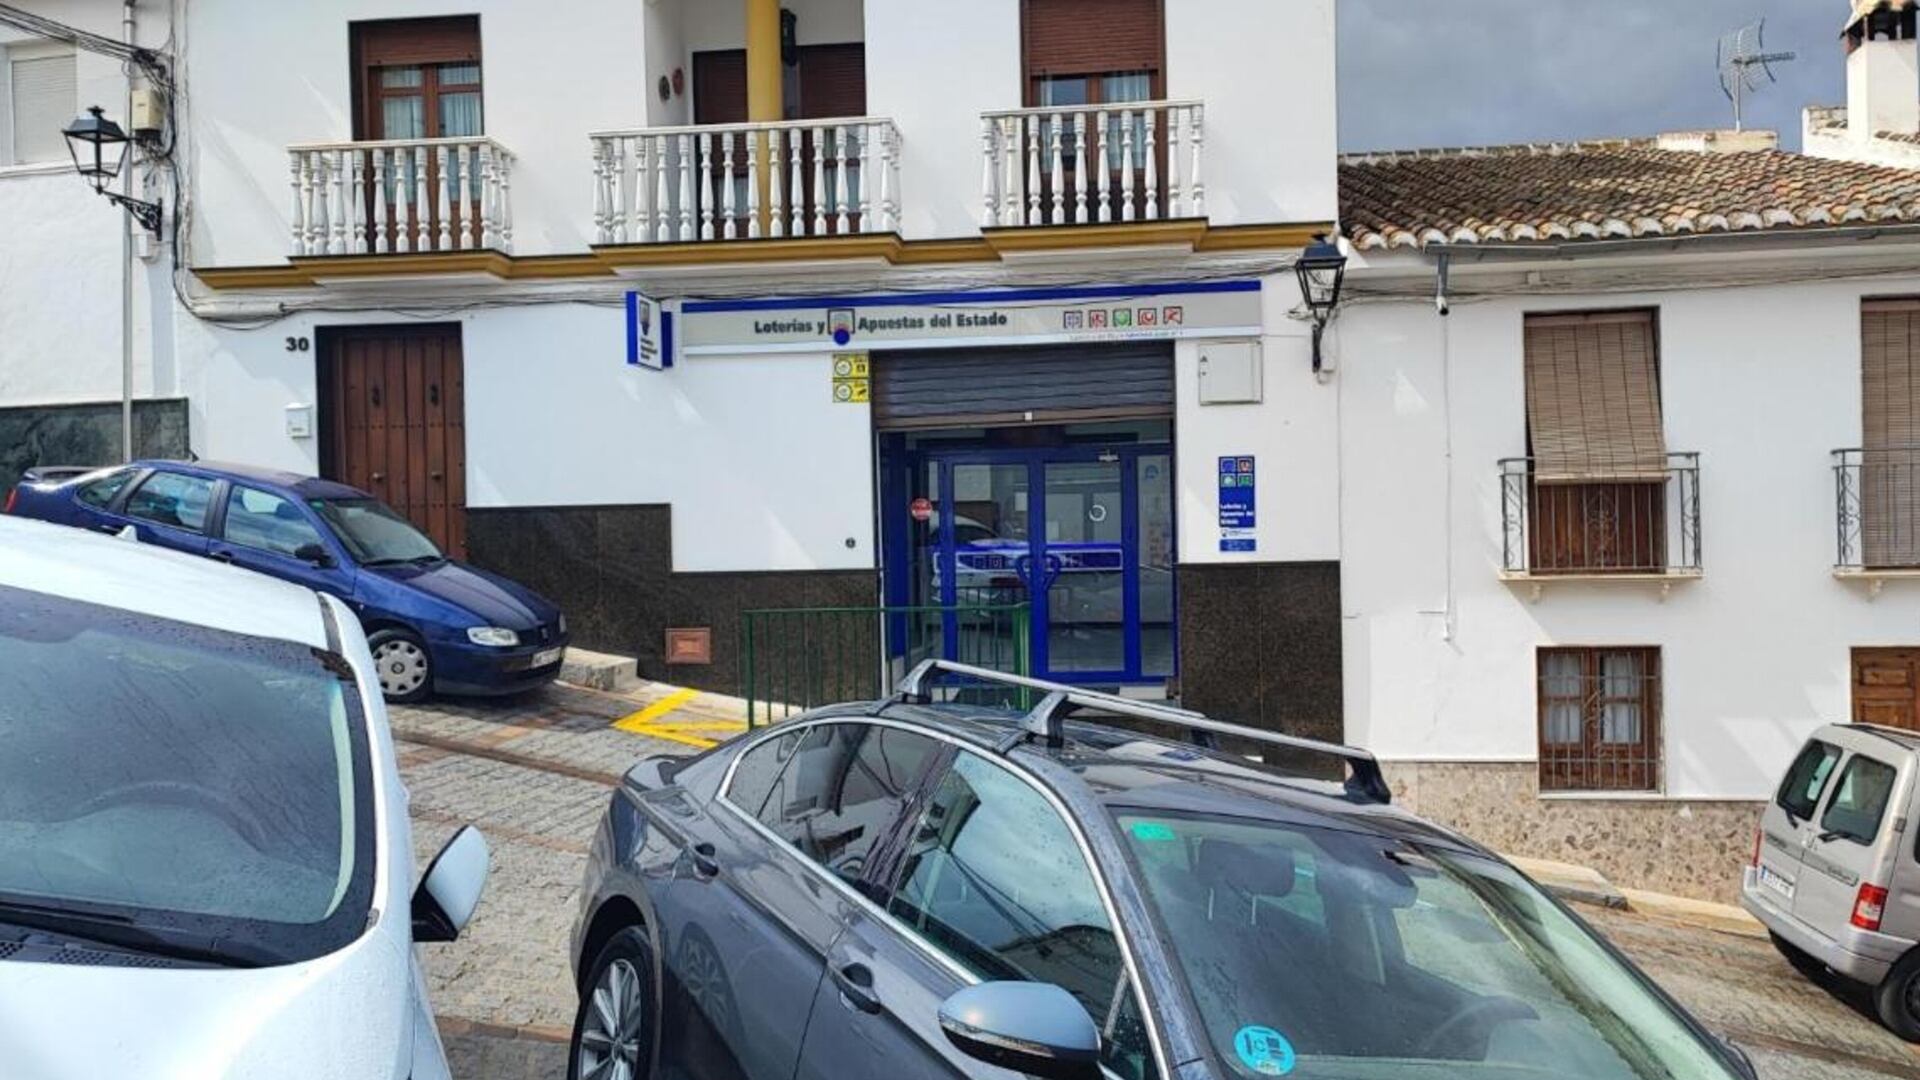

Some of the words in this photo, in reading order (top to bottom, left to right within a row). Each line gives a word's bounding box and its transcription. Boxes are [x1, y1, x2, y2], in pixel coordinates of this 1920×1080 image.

[816, 321, 826, 336] y
[858, 316, 925, 334] Apuestas
[930, 313, 952, 328] del
[956, 311, 1008, 327] Estado
[285, 336, 309, 351] 30
